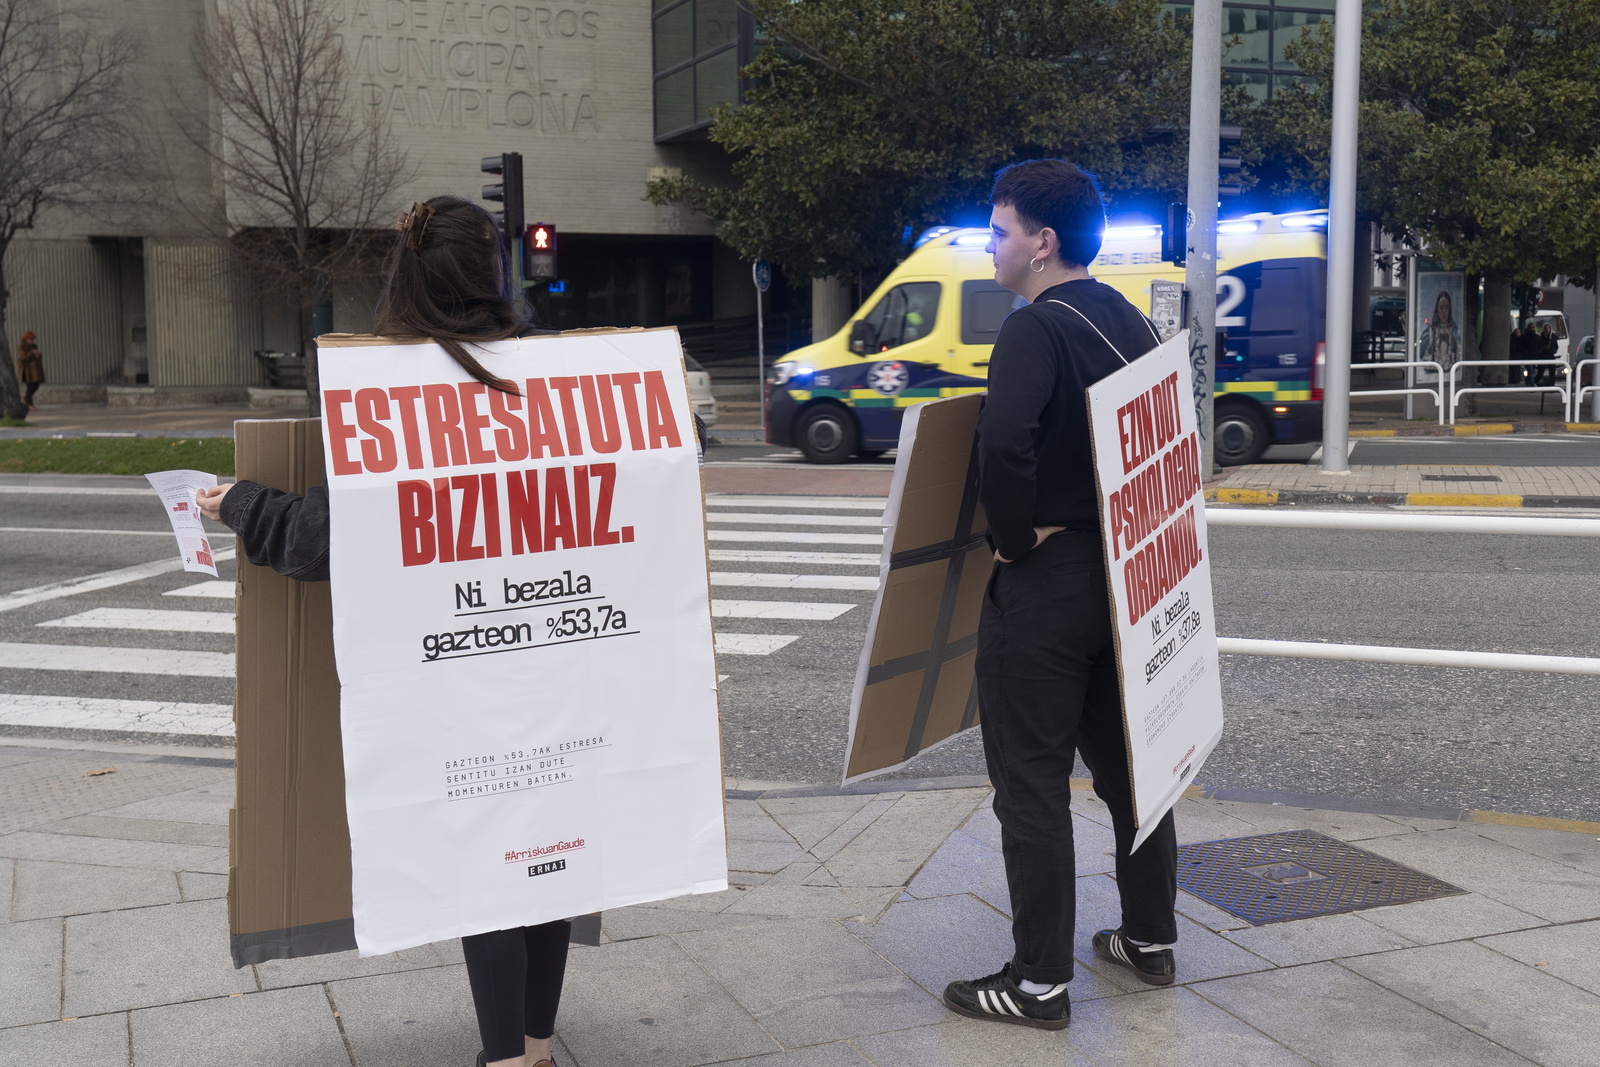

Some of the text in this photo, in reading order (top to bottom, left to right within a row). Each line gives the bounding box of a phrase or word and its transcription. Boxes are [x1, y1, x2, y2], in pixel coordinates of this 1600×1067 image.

[386, 0, 429, 30] DE
[438, 1, 600, 40] AHORROS
[331, 33, 558, 84] MUNICIPAL
[361, 83, 599, 133] PAMPLONA
[323, 370, 682, 476] ESTRESATUTA
[1116, 389, 1151, 476] EZIN
[1151, 370, 1182, 450] DUT
[397, 462, 635, 567] BIZI NAIZ.
[1109, 431, 1201, 561] PSIKOLOGOA
[454, 570, 592, 609] Ni bezala
[1123, 504, 1203, 627] ORDAINDU.
[422, 605, 627, 660] gazteon %53,7a
[1151, 591, 1190, 640] Ni bezala
[1145, 610, 1201, 683] gazteon %37,8a
[445, 754, 496, 769] GAZTEON
[559, 736, 604, 751] ESTRESA
[446, 757, 565, 784] SENTITU IZAN DUTE
[447, 771, 573, 798] MOMENTUREN BATEAN.
[504, 838, 585, 862] #ArriskuanGaude
[529, 860, 565, 876] ERNAI
